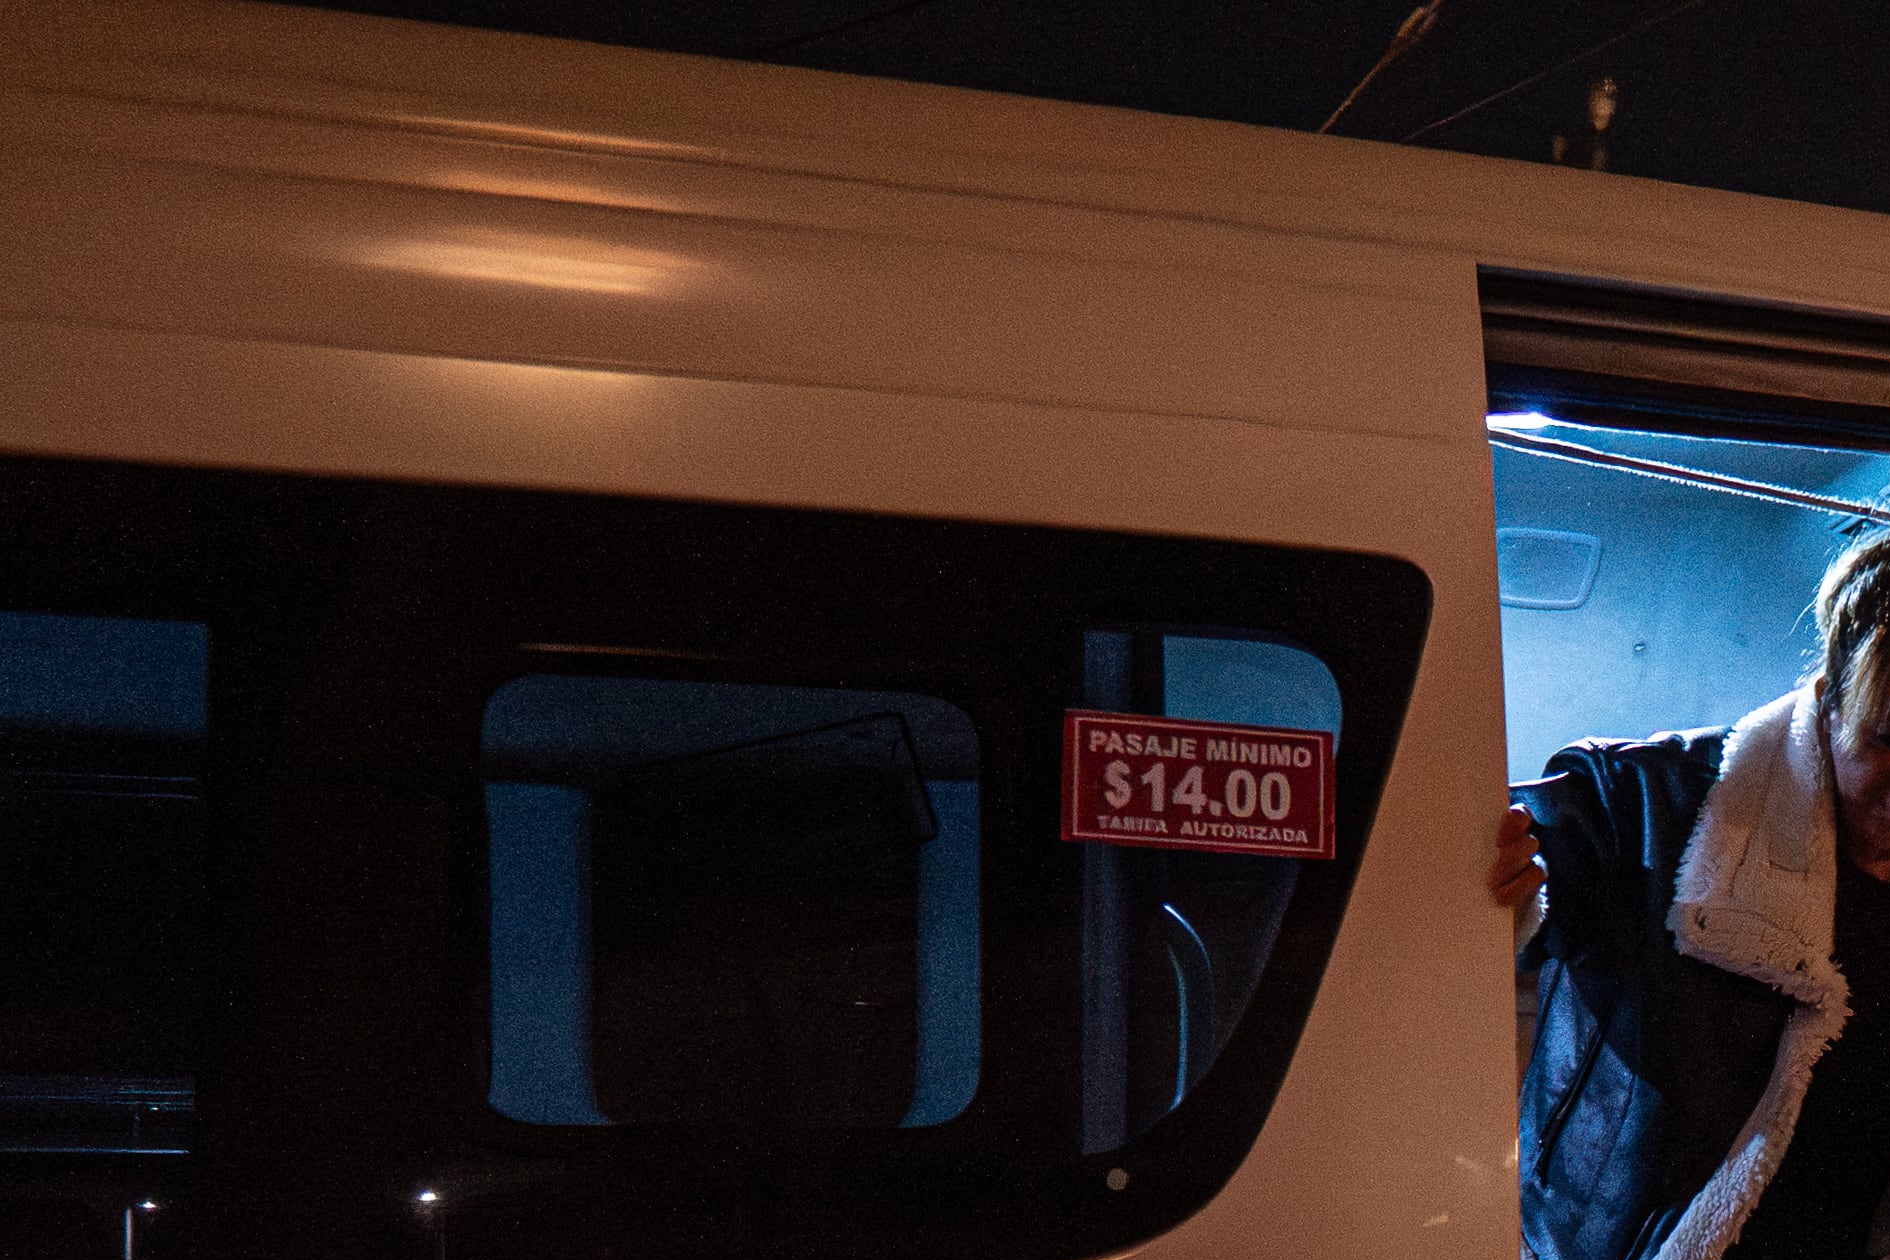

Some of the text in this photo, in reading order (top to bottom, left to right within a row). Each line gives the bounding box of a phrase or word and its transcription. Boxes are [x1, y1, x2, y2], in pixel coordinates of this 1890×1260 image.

[1089, 730, 1197, 760] PASAJE
[1103, 759, 1292, 821] $14.00
[1097, 815, 1309, 844] TARIFA AUTORIZADA
